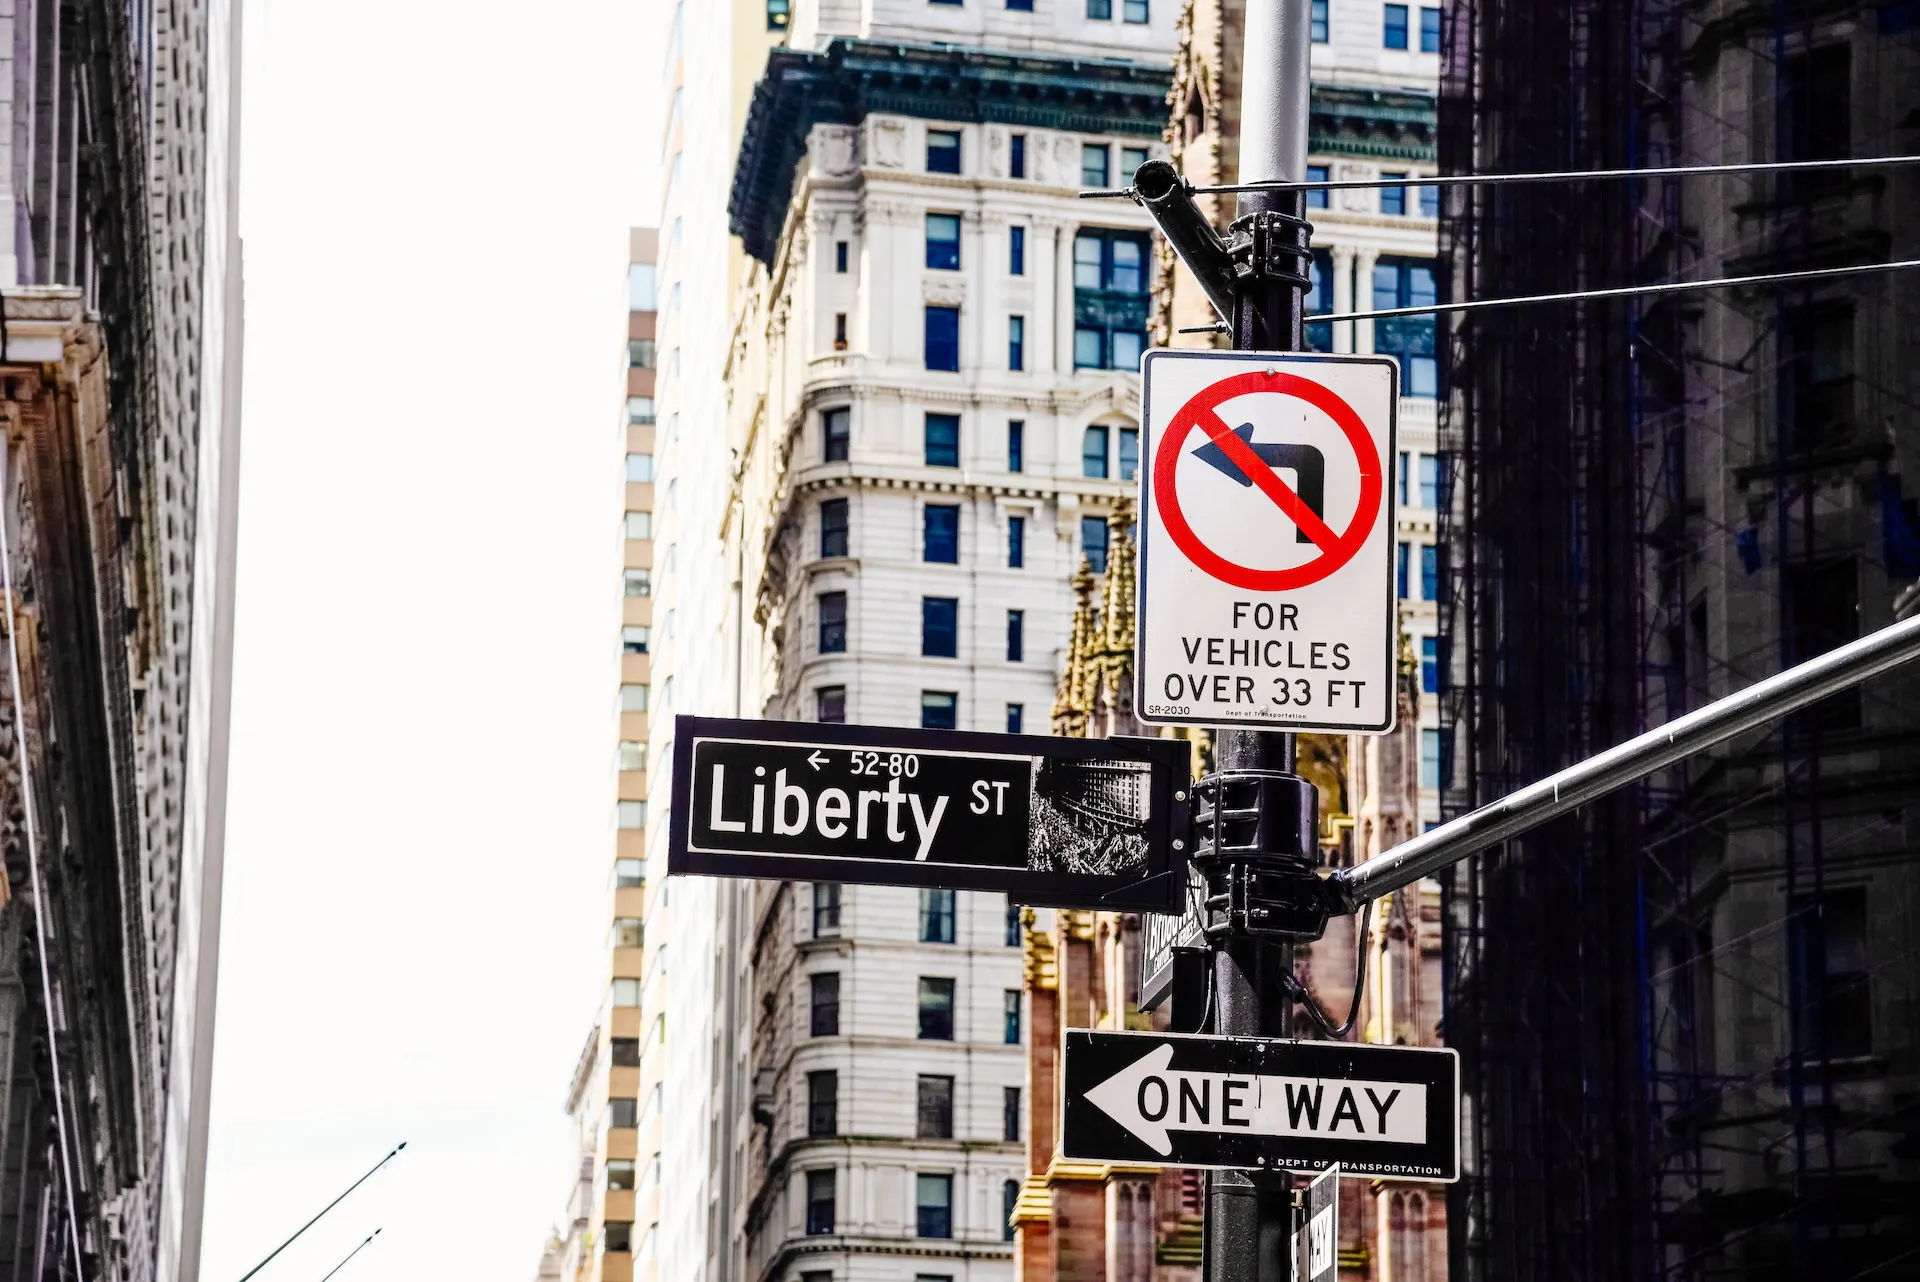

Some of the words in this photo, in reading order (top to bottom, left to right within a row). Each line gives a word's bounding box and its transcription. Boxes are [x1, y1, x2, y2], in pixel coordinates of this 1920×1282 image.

[1232, 601, 1299, 631] FOR
[1181, 636, 1351, 671] VEHICLES
[1164, 673, 1255, 704] OVER
[1271, 678, 1312, 706] 33
[1327, 680, 1366, 708] FT
[1148, 705, 1191, 715] SR-2030
[1254, 711, 1307, 720] Transportation
[850, 751, 920, 778] 52-80
[710, 763, 950, 861] Liberty
[969, 779, 1010, 816] ST
[1137, 1075, 1250, 1127] ONE
[1285, 1083, 1402, 1134] WAY
[1277, 1158, 1309, 1167] DEPT
[1313, 1160, 1329, 1169] OF
[1341, 1162, 1442, 1175] RANSPORTATION
